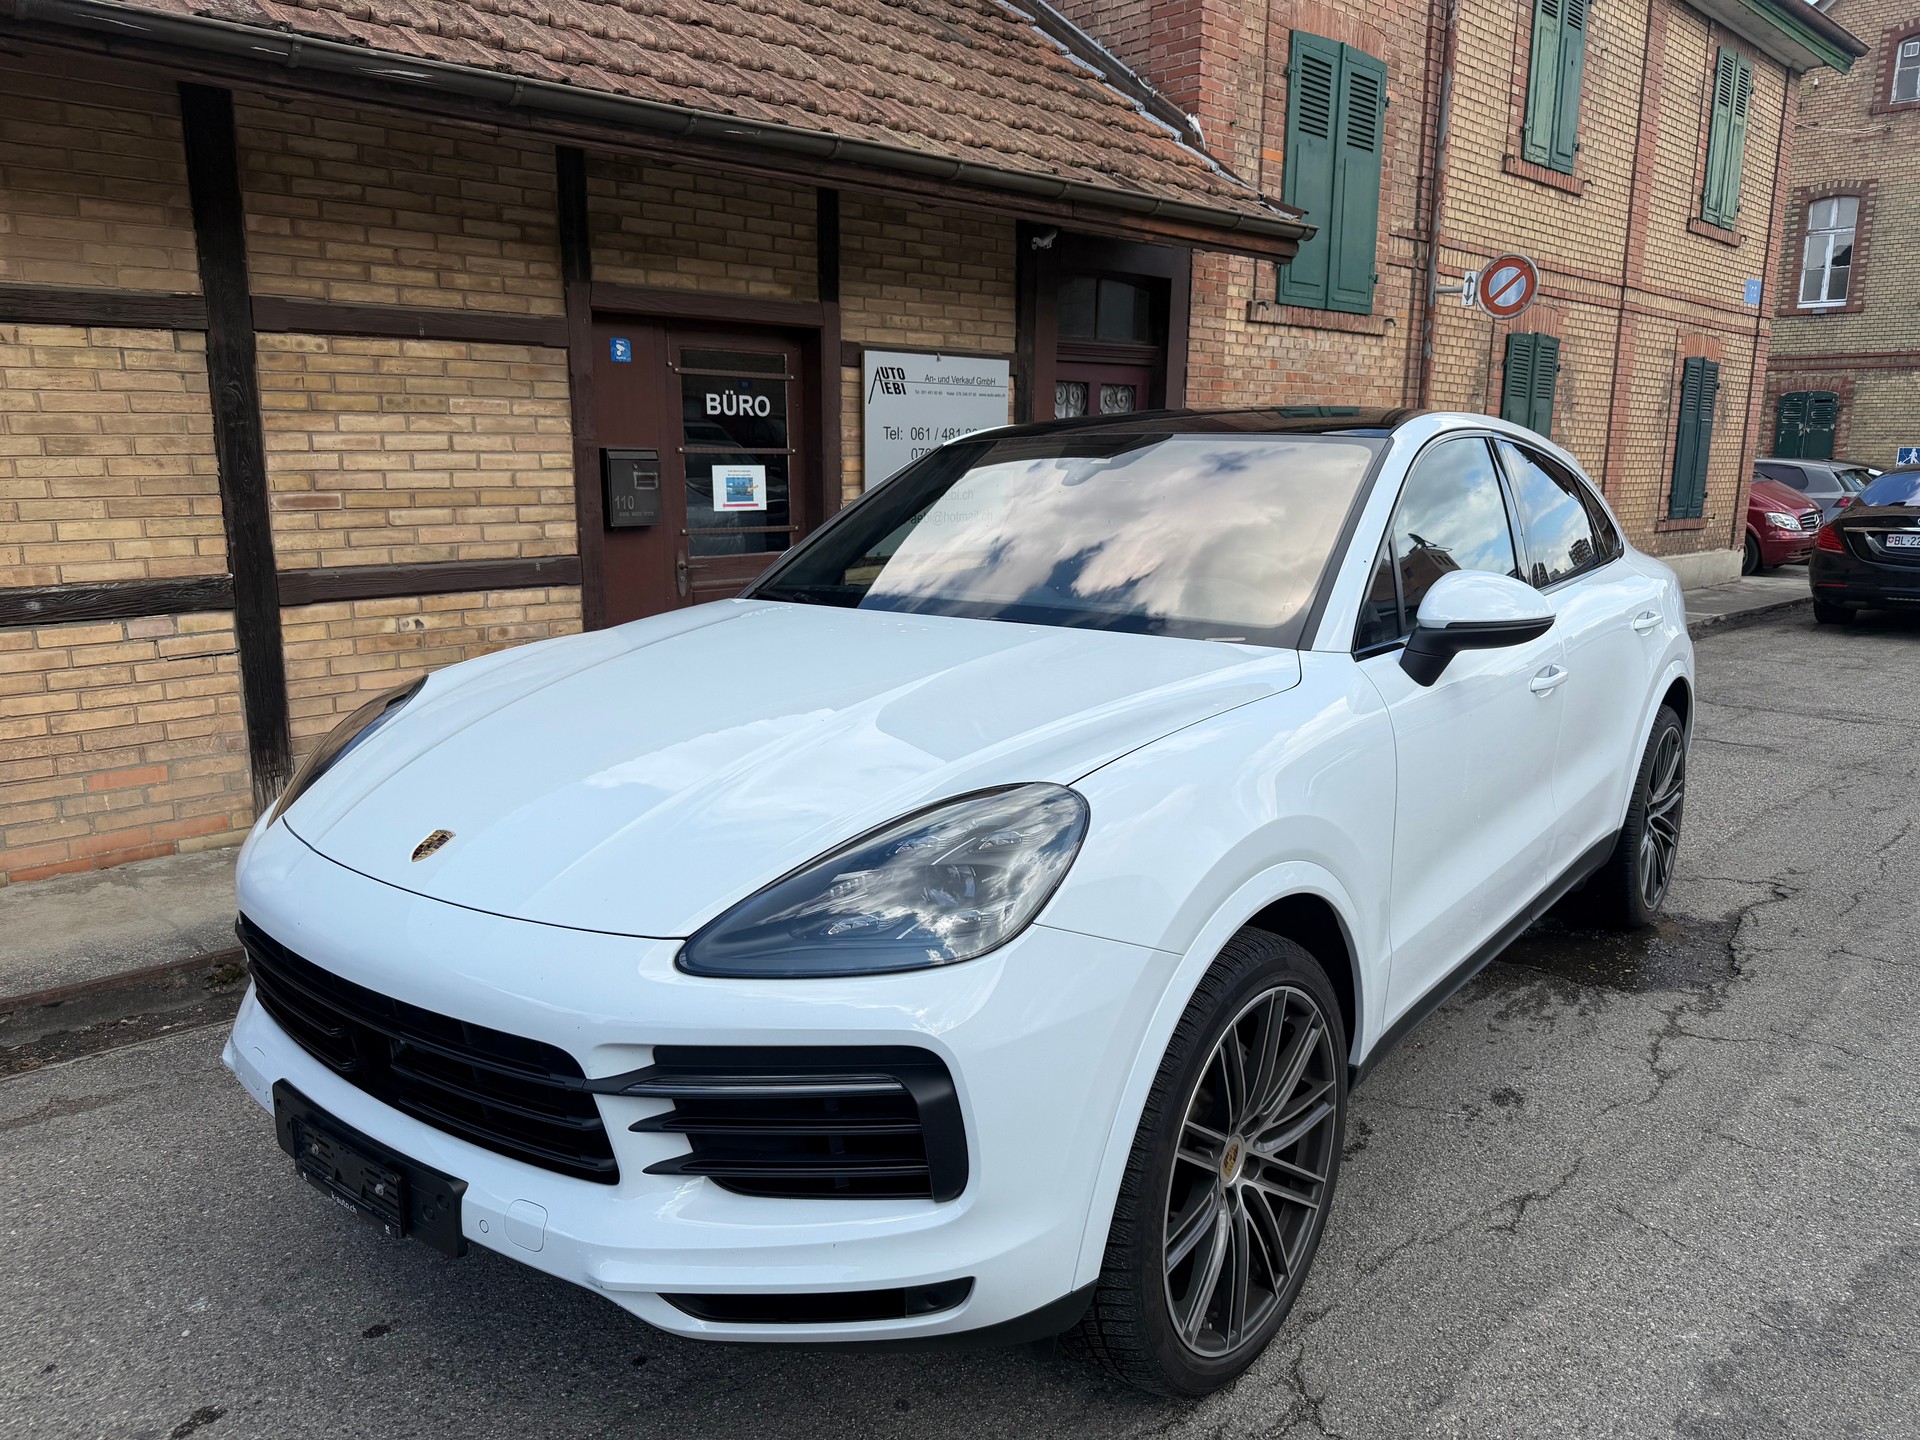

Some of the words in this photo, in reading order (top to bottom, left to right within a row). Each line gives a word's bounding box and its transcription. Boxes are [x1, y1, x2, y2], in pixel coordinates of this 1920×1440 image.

[924, 374, 936, 383] An-
[937, 375, 950, 384] und
[951, 375, 975, 386] Verkauf
[976, 377, 996, 387] GmbH
[705, 389, 771, 418] BÜRO
[883, 426, 903, 441] Tel:
[910, 427, 931, 441] 061
[934, 427, 939, 441] /
[614, 495, 635, 510] 110
